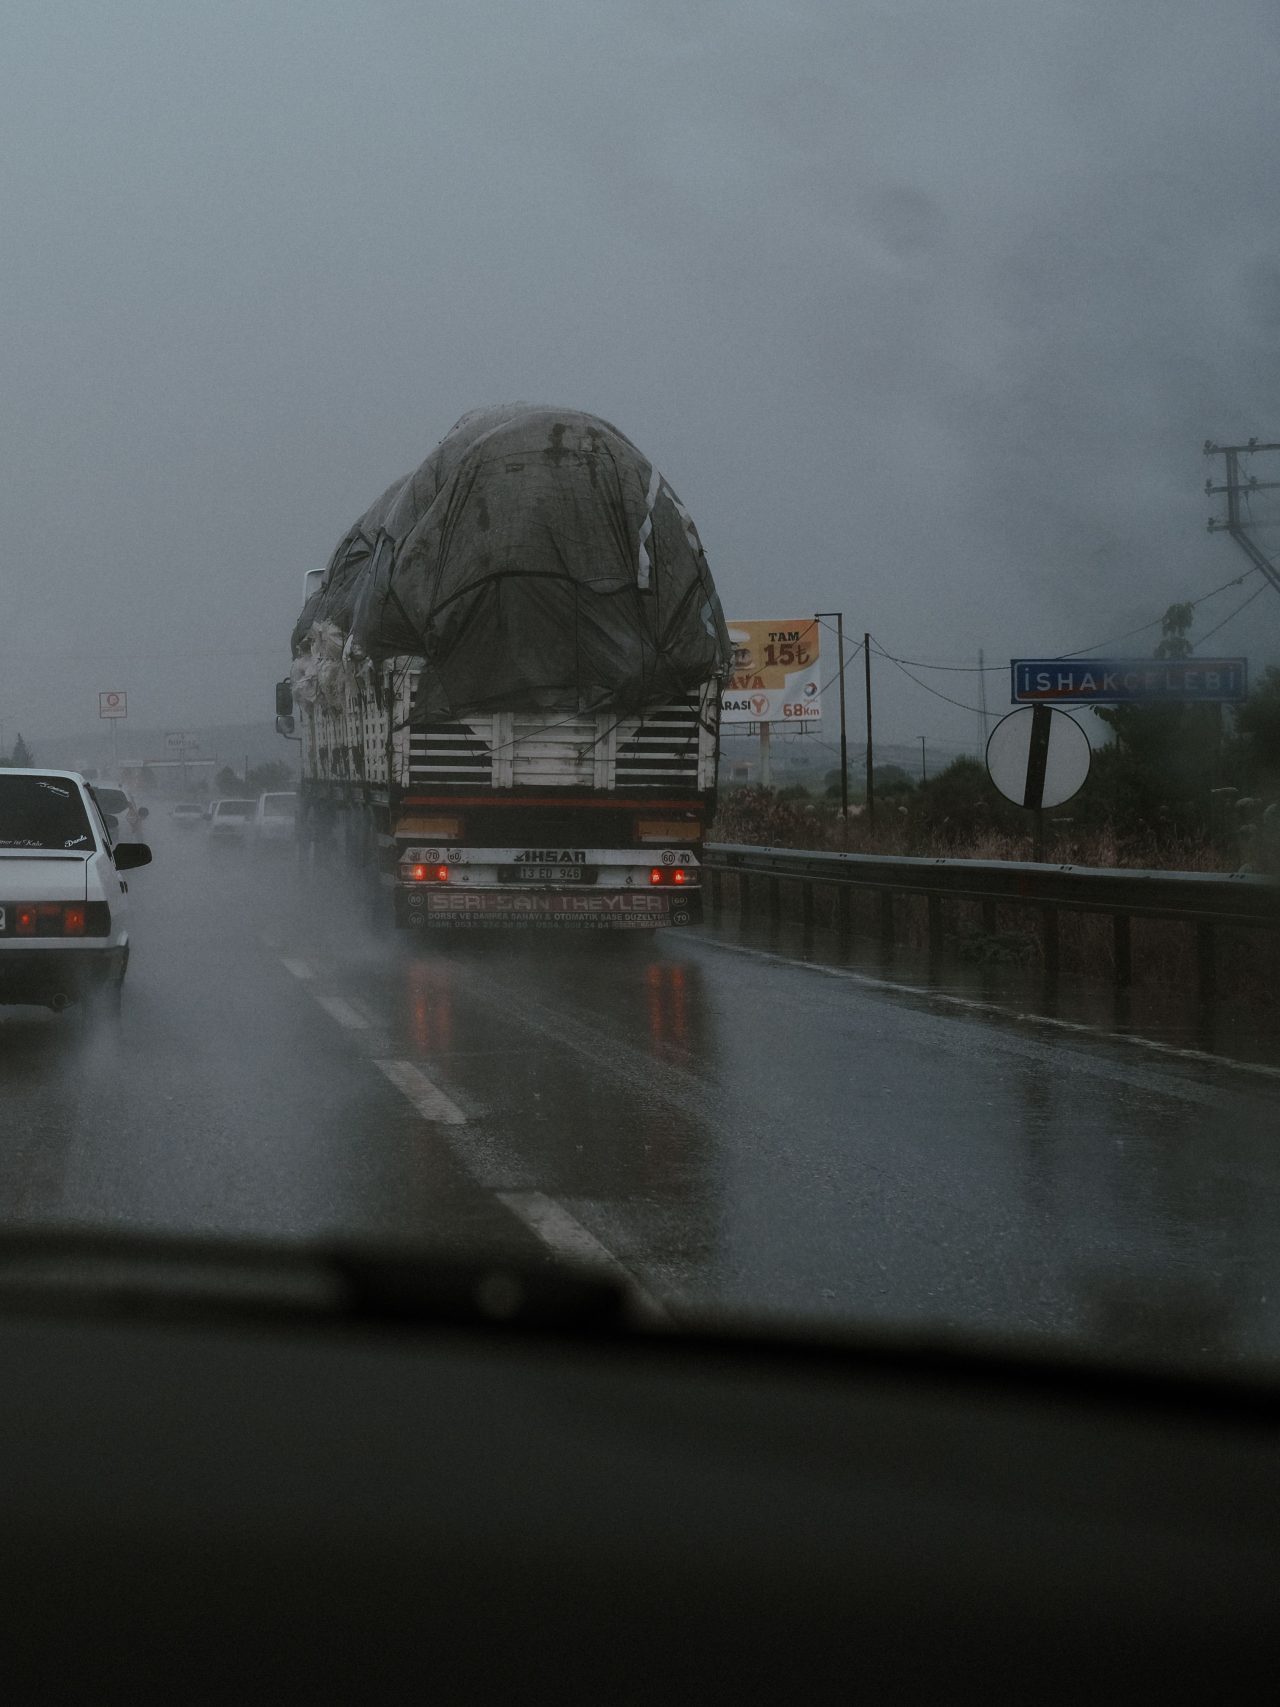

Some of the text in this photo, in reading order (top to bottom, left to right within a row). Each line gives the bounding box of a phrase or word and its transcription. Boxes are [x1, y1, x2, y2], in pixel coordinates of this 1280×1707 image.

[768, 631, 800, 642] TAM
[680, 854, 690, 863] 70
[522, 868, 535, 878] 13
[560, 895, 662, 910] TREYLER
[459, 912, 471, 920] VE
